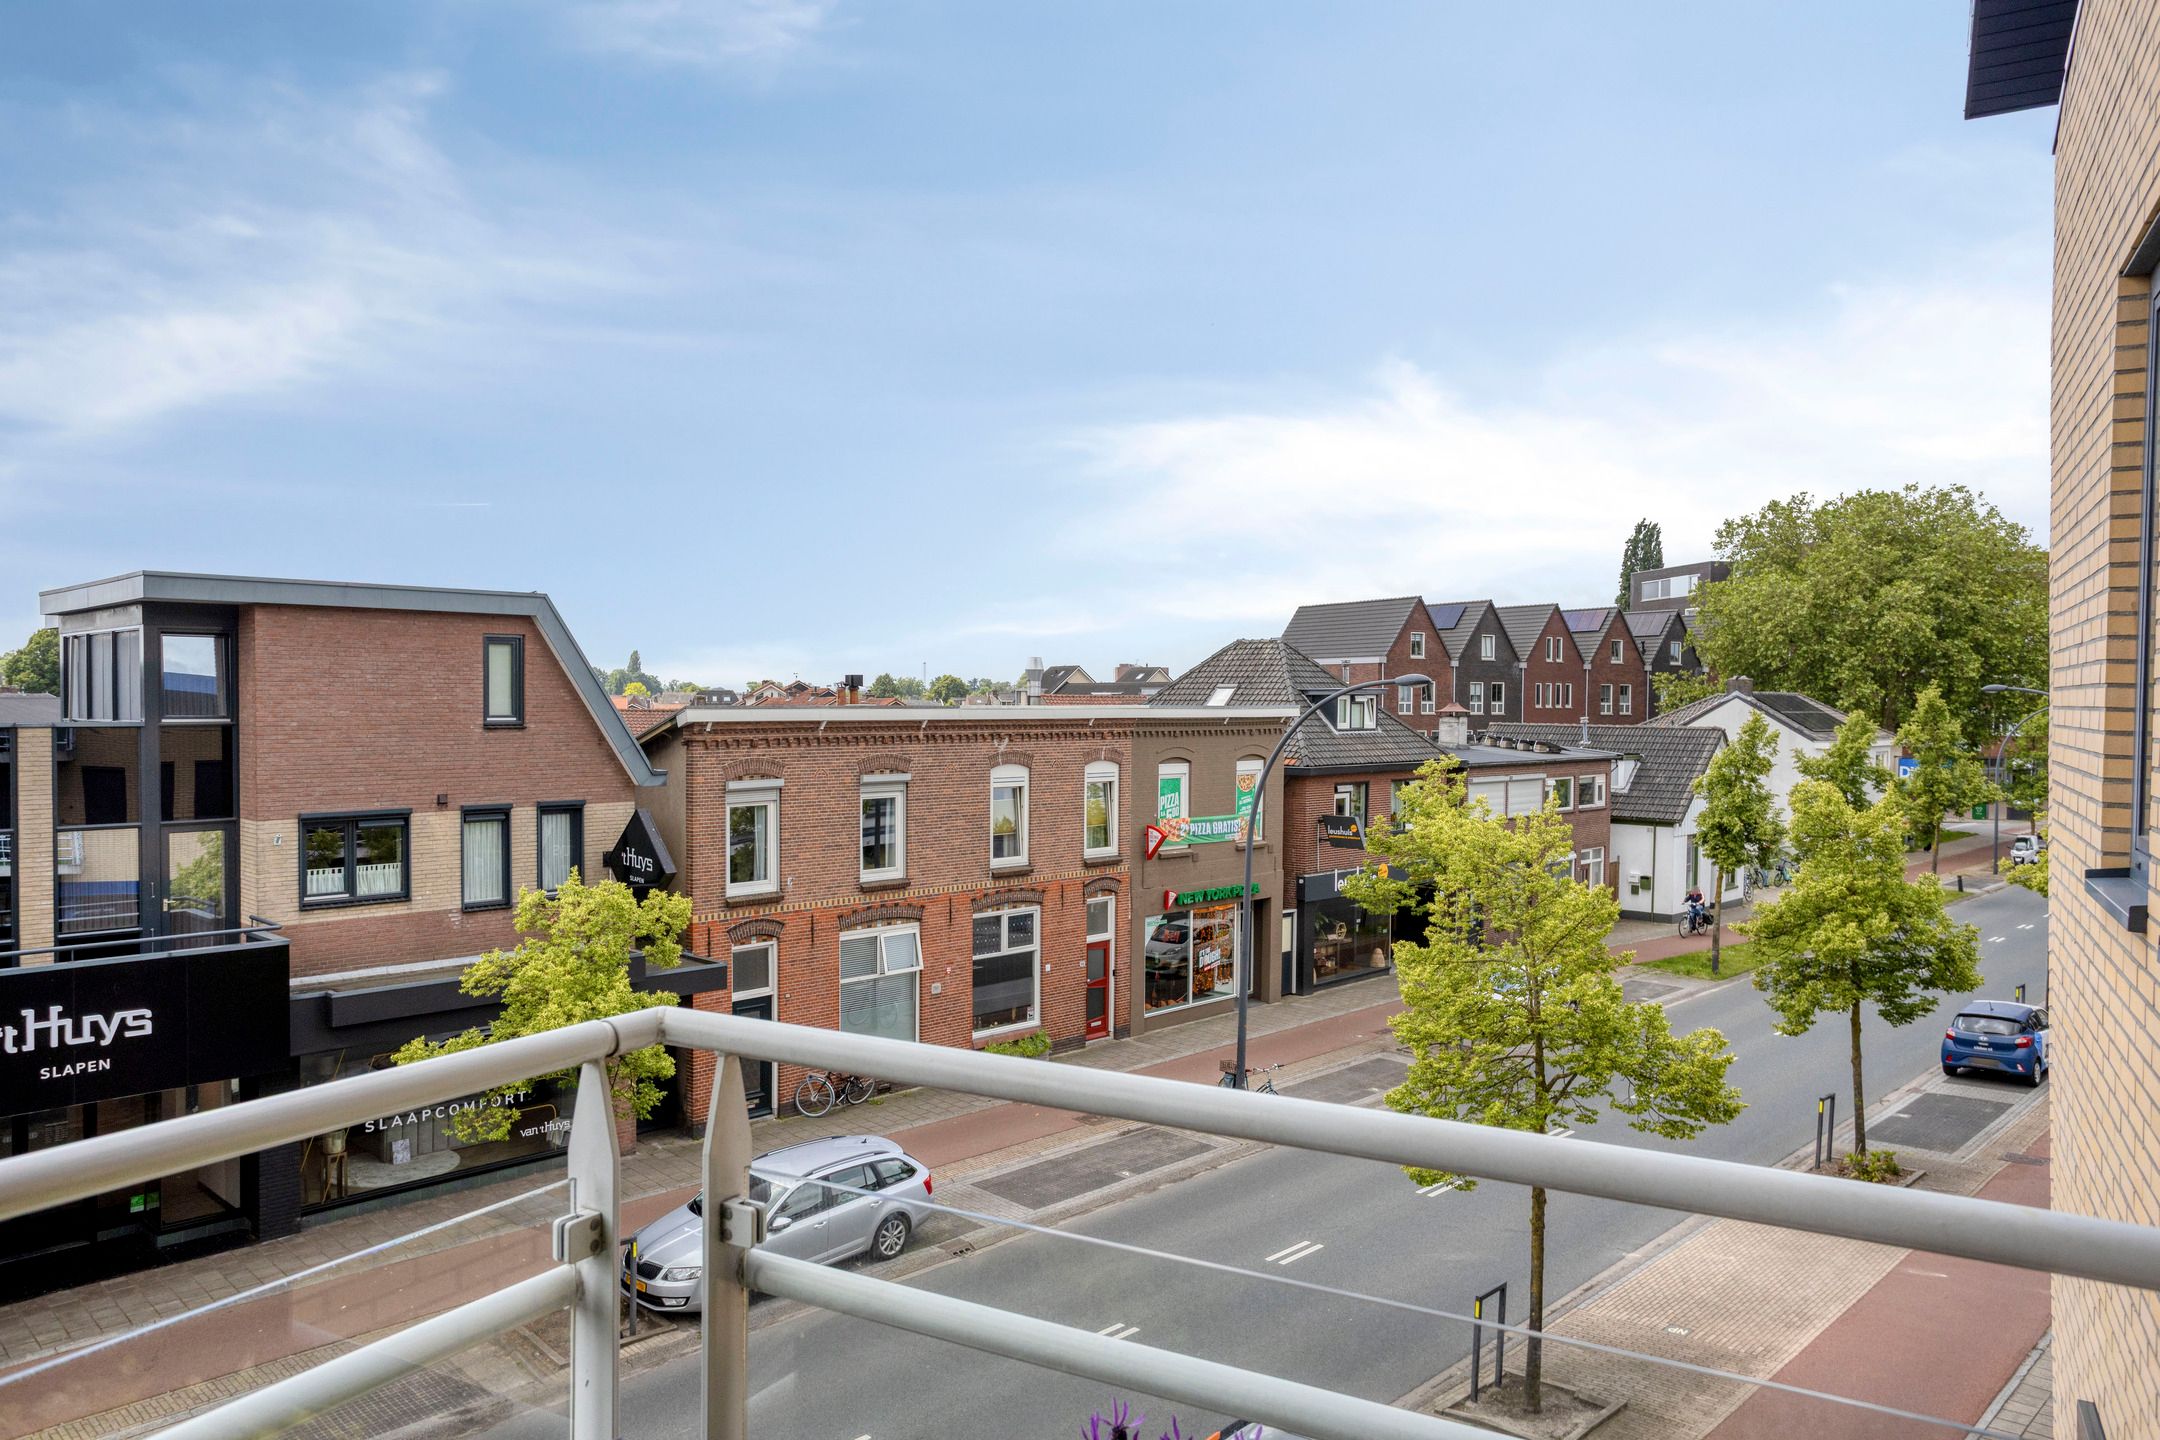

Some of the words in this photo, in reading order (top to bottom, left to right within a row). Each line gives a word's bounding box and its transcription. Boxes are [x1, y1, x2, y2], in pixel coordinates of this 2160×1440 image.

[1190, 822, 1212, 836] PIZZA
[1177, 889, 1204, 906] NEW
[1206, 886, 1232, 901] YORK
[1232, 882, 1260, 897] PIA
[39, 1058, 112, 1080] SLAPEN
[519, 1126, 539, 1137] van
